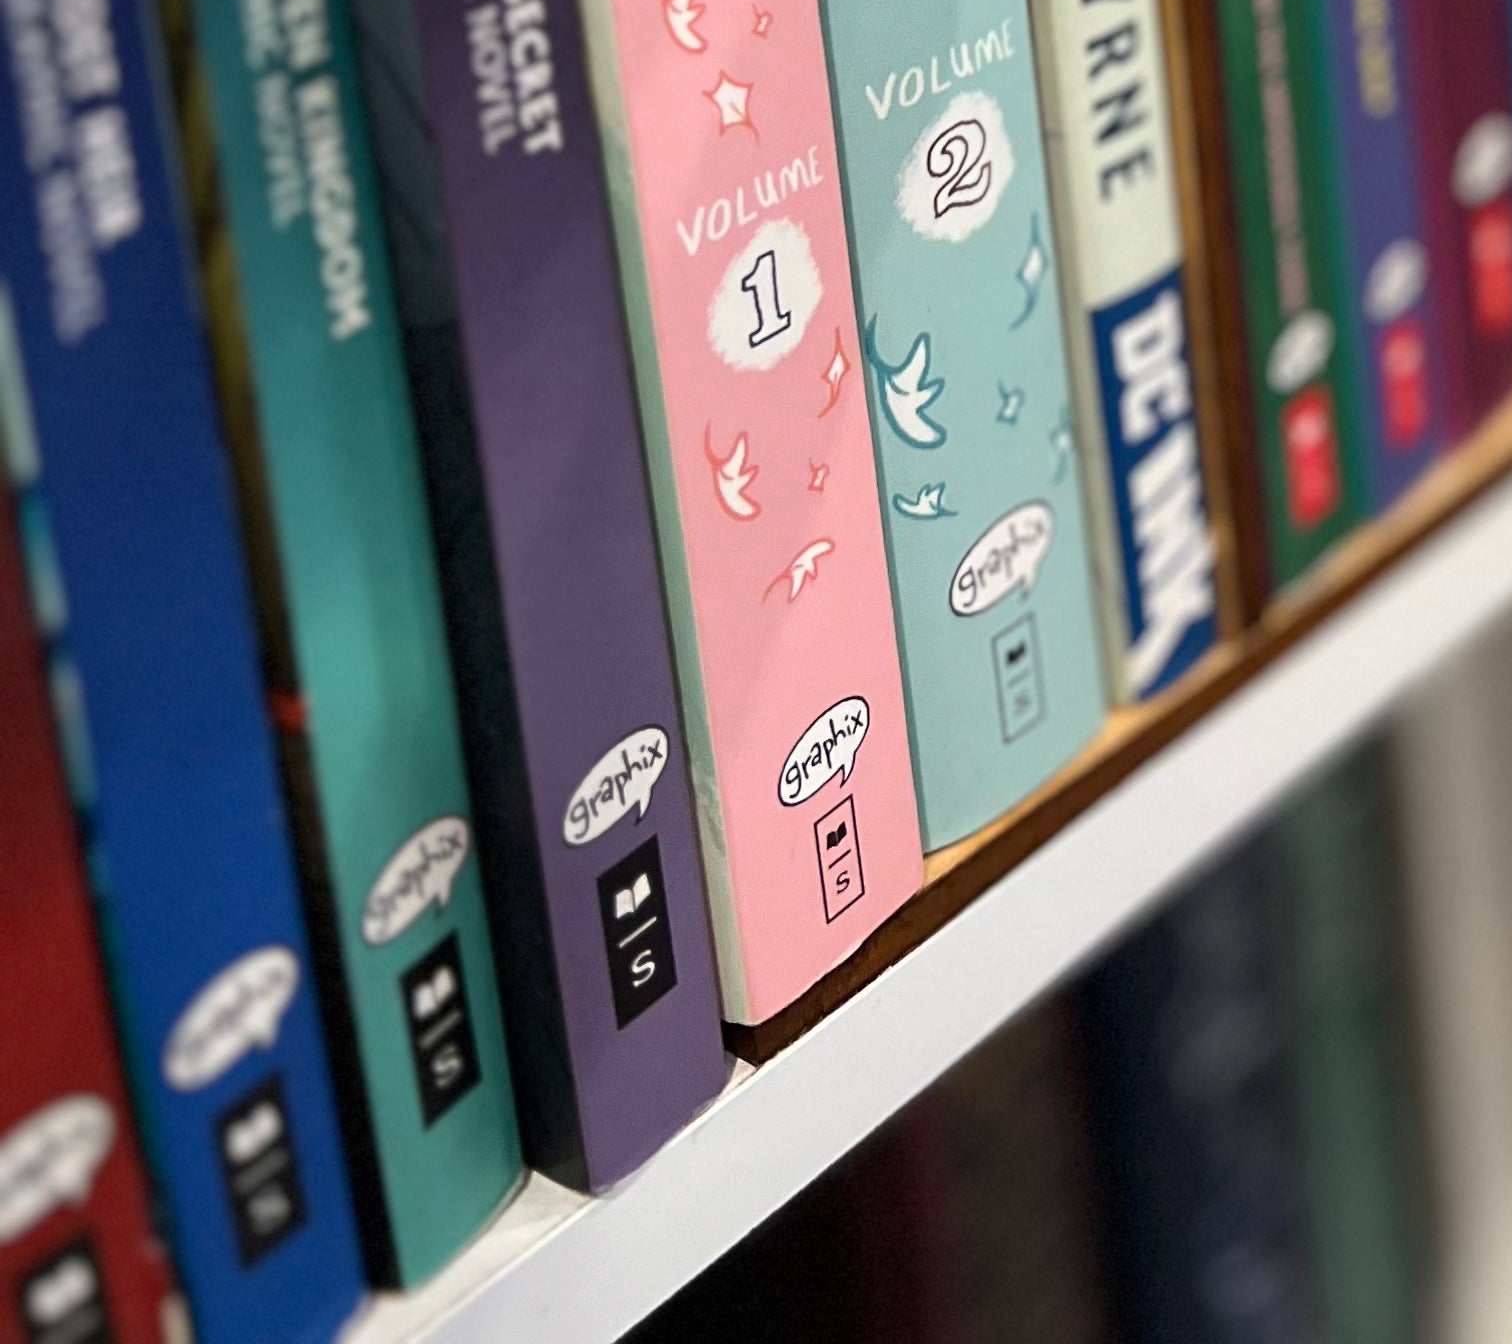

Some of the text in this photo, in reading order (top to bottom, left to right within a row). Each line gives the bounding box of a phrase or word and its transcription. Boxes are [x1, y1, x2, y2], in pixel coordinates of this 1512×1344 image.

[464, 2, 519, 156] NOVEL
[865, 18, 1015, 120] VOLUME
[297, 75, 371, 340] KINGDOM
[676, 145, 824, 257] VOLUME
[927, 118, 992, 219] 2
[741, 249, 791, 349] 1
[1110, 287, 1194, 446] DC
[957, 517, 1045, 608] graphix
[570, 738, 663, 841] graphix
[784, 709, 865, 799] graphix
[835, 870, 851, 895] S
[631, 949, 656, 988] S
[431, 1045, 464, 1089] S
